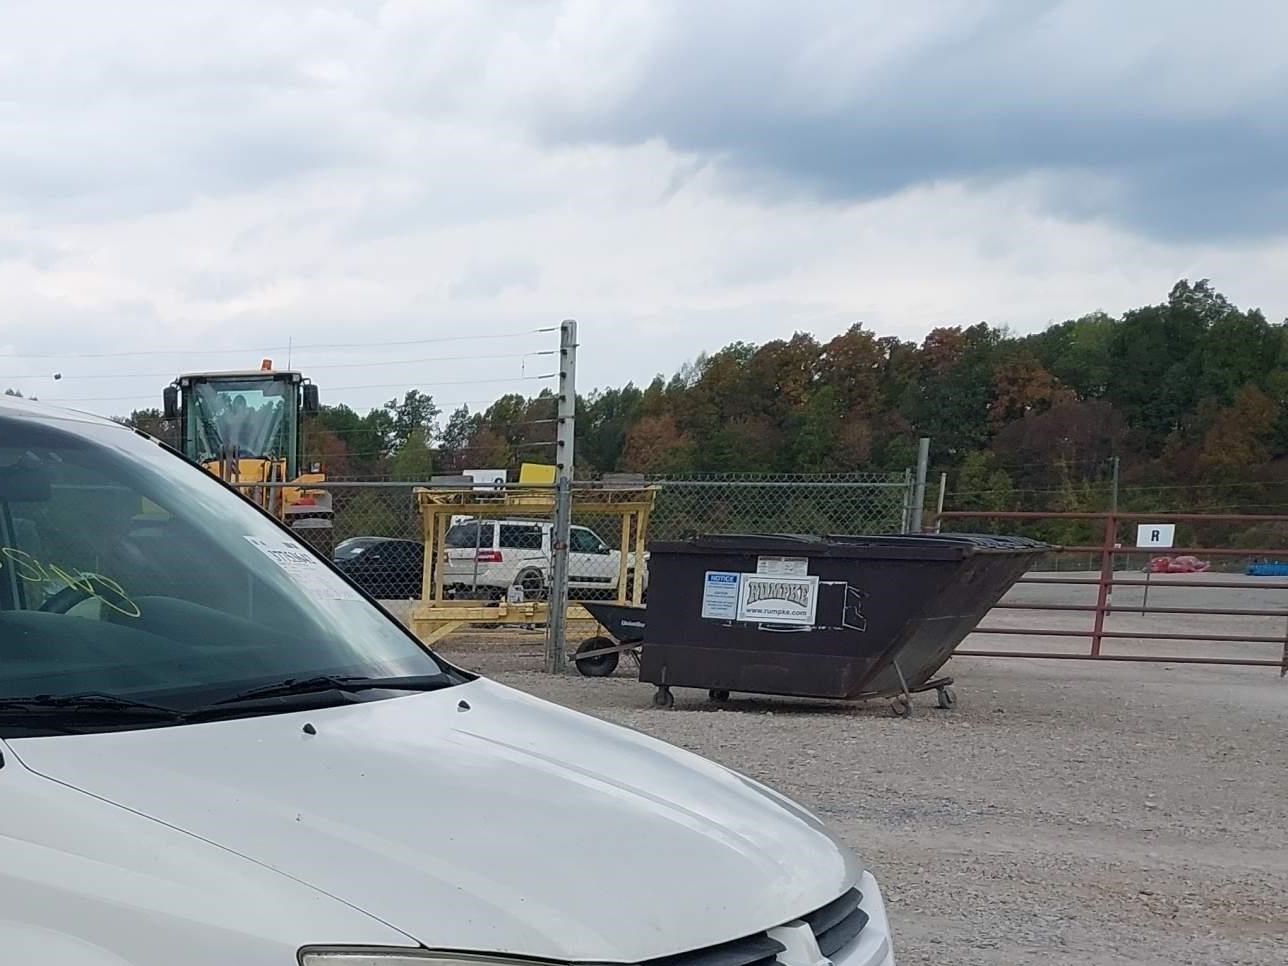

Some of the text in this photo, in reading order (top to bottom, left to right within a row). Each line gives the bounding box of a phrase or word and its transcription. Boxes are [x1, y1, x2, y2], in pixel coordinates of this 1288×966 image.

[1151, 529, 1161, 542] R
[746, 581, 810, 608] RUMPKE
[746, 607, 808, 617] www.rumpke.com
